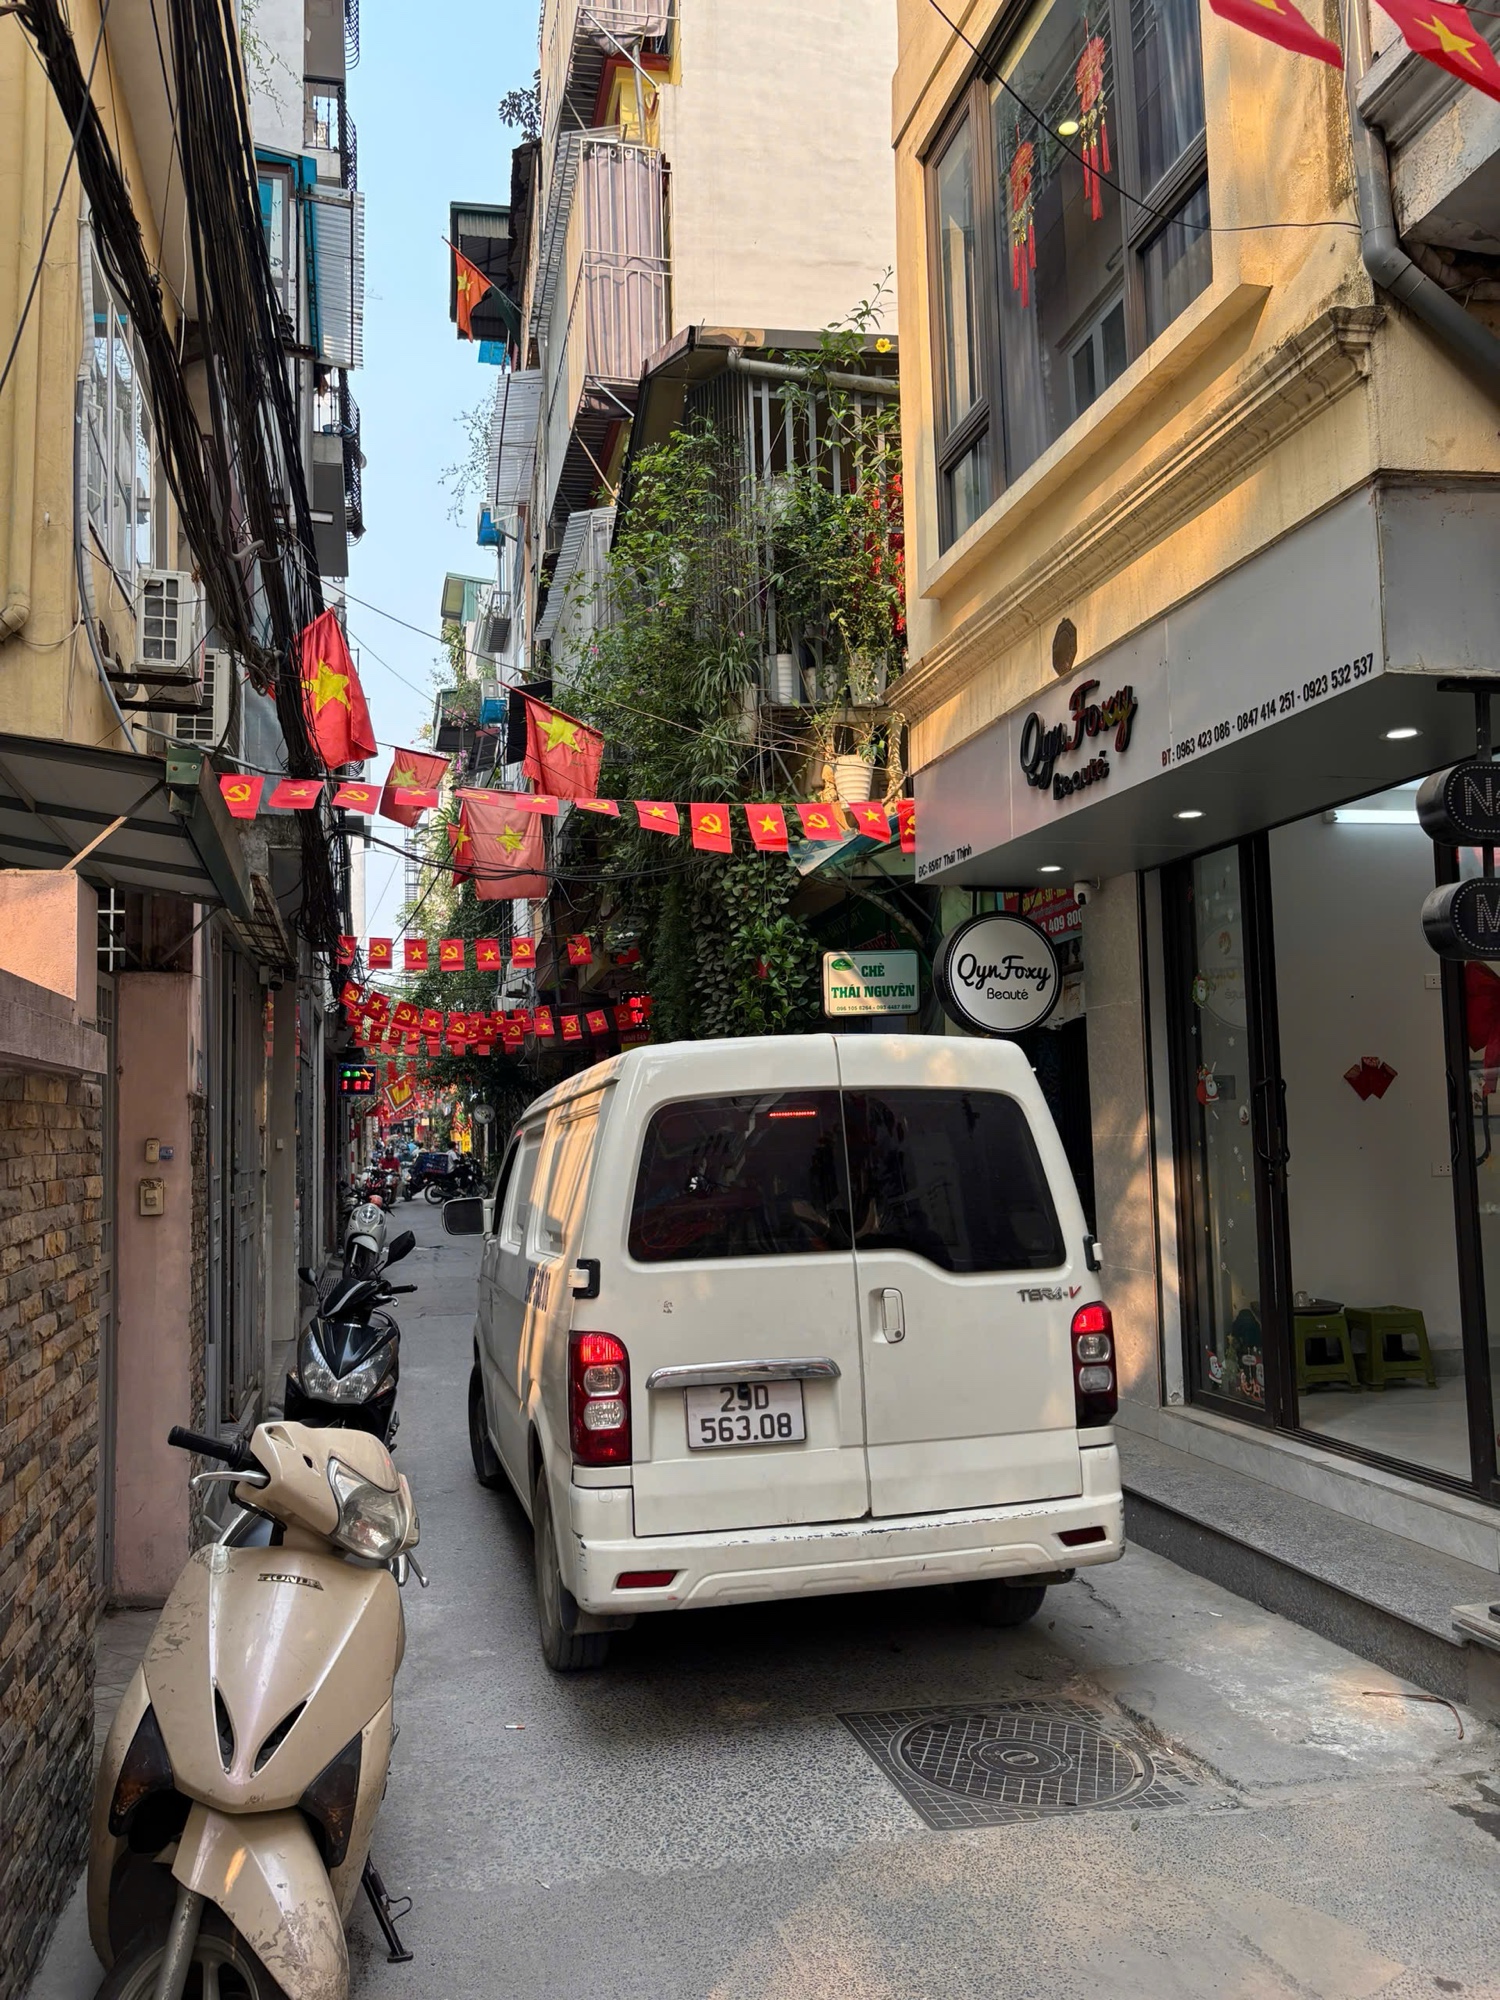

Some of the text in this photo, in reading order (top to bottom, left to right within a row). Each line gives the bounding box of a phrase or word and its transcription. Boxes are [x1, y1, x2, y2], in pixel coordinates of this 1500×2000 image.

[1176, 738, 1196, 760] 0963
[1197, 729, 1212, 750] 423
[1214, 720, 1230, 742] 086
[1237, 708, 1259, 732] 0847
[1260, 699, 1276, 721] 414
[1279, 690, 1295, 713] 251
[1303, 675, 1328, 701] 0923
[1331, 664, 1351, 689] 532
[1354, 653, 1374, 679] 537
[1020, 679, 1138, 789] QynFoxy
[1053, 750, 1110, 800] Beauté
[1048, 915, 1065, 933] 409
[861, 962, 885, 977] CHÈ
[957, 953, 1051, 991] QynFoxy
[831, 982, 915, 998] THÁI NGUYÊN
[986, 987, 1029, 1000] Beauté
[700, 1413, 792, 1443] 563.08
